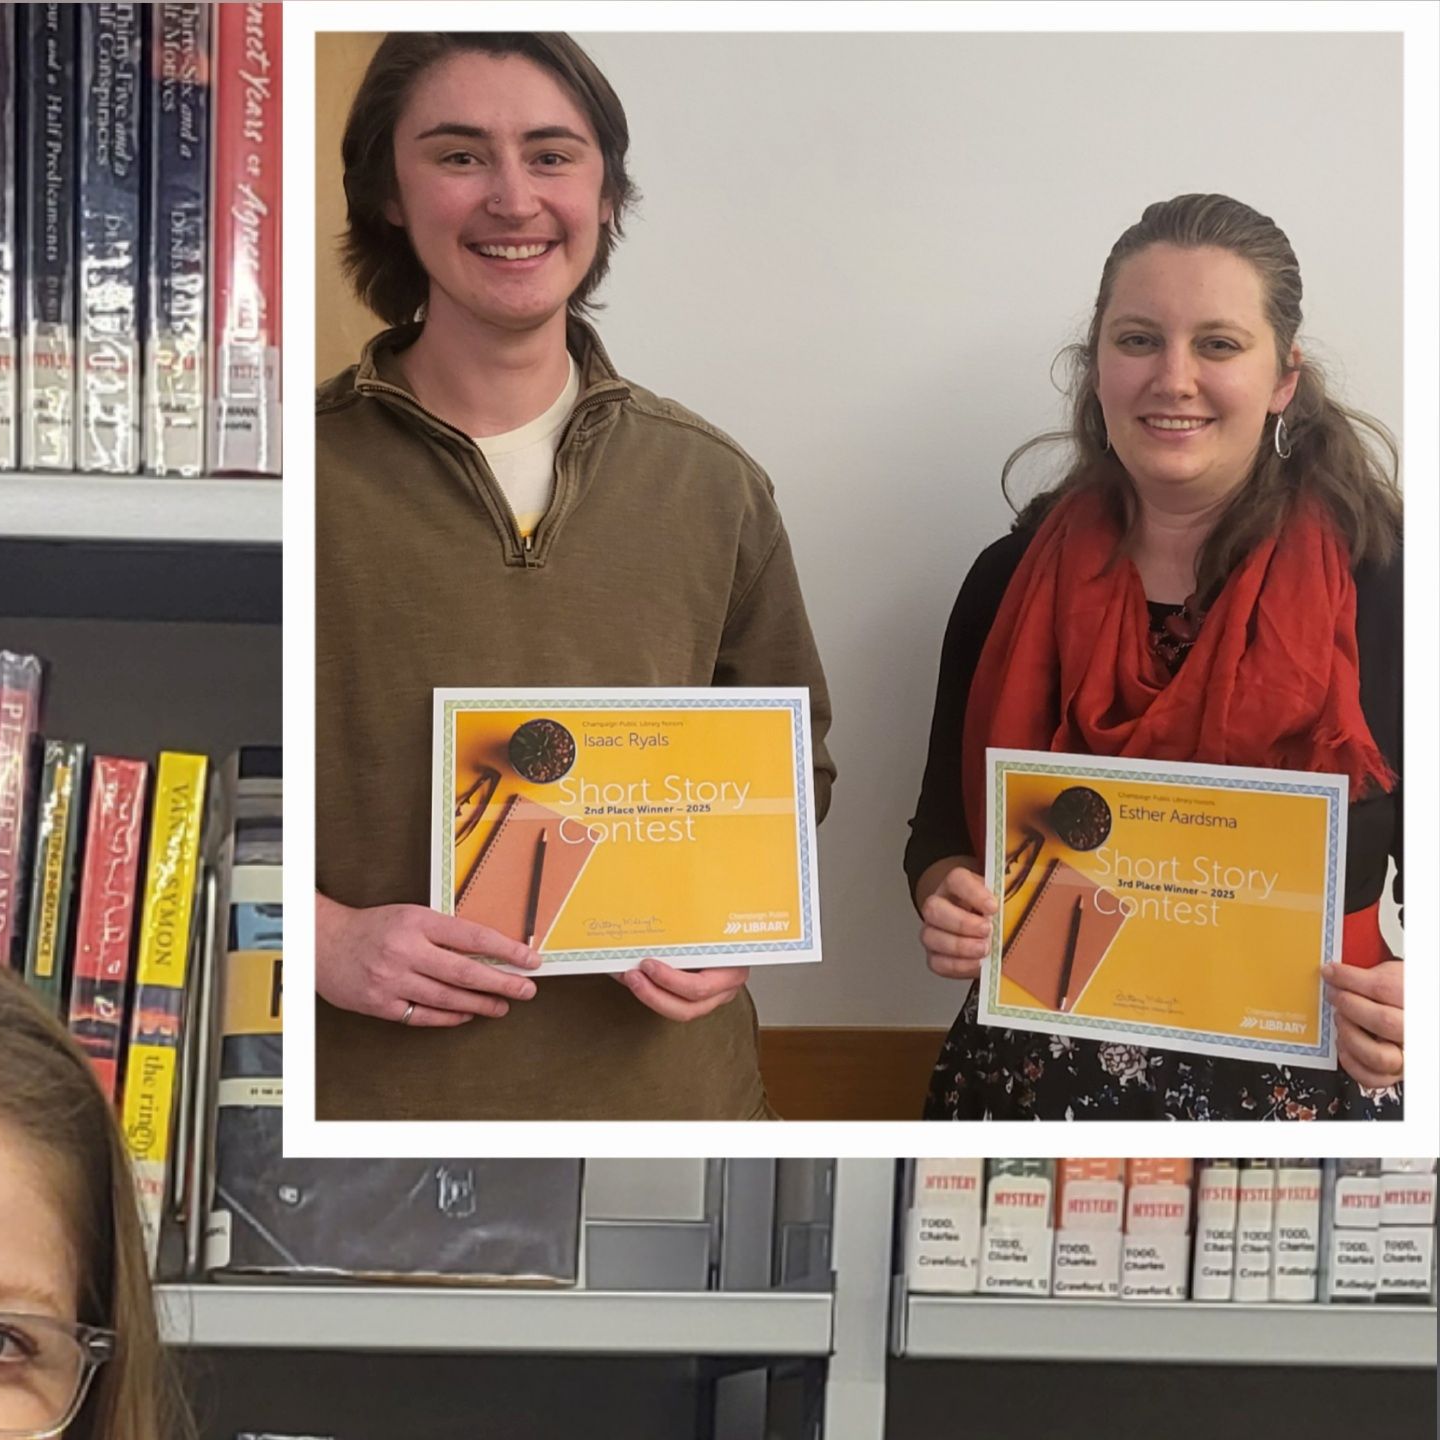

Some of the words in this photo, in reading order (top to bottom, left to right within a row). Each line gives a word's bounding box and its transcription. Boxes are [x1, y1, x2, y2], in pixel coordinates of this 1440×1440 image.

[239, 66, 271, 143] Years
[584, 734, 623, 747] Isaac
[629, 732, 669, 749] Ryals
[558, 777, 651, 805] Short
[663, 775, 750, 808] Story
[584, 806, 604, 815] 2nd
[607, 806, 634, 815] Place
[637, 805, 673, 814] Winner
[686, 804, 711, 812] 2025
[1119, 804, 1165, 822] Esther
[1170, 809, 1237, 829] Aardsma
[559, 815, 696, 844] Contest
[1094, 846, 1180, 882] Short
[1193, 856, 1278, 900] Story
[1118, 879, 1133, 889] 3rd
[1135, 880, 1161, 892] Place
[1163, 883, 1198, 896] Winner
[1210, 889, 1235, 900] 2025
[1094, 886, 1220, 927] Contest
[743, 921, 790, 933] LIBRARY
[1259, 1019, 1307, 1034] LIBRARY
[995, 1192, 1045, 1207] MYSTERY
